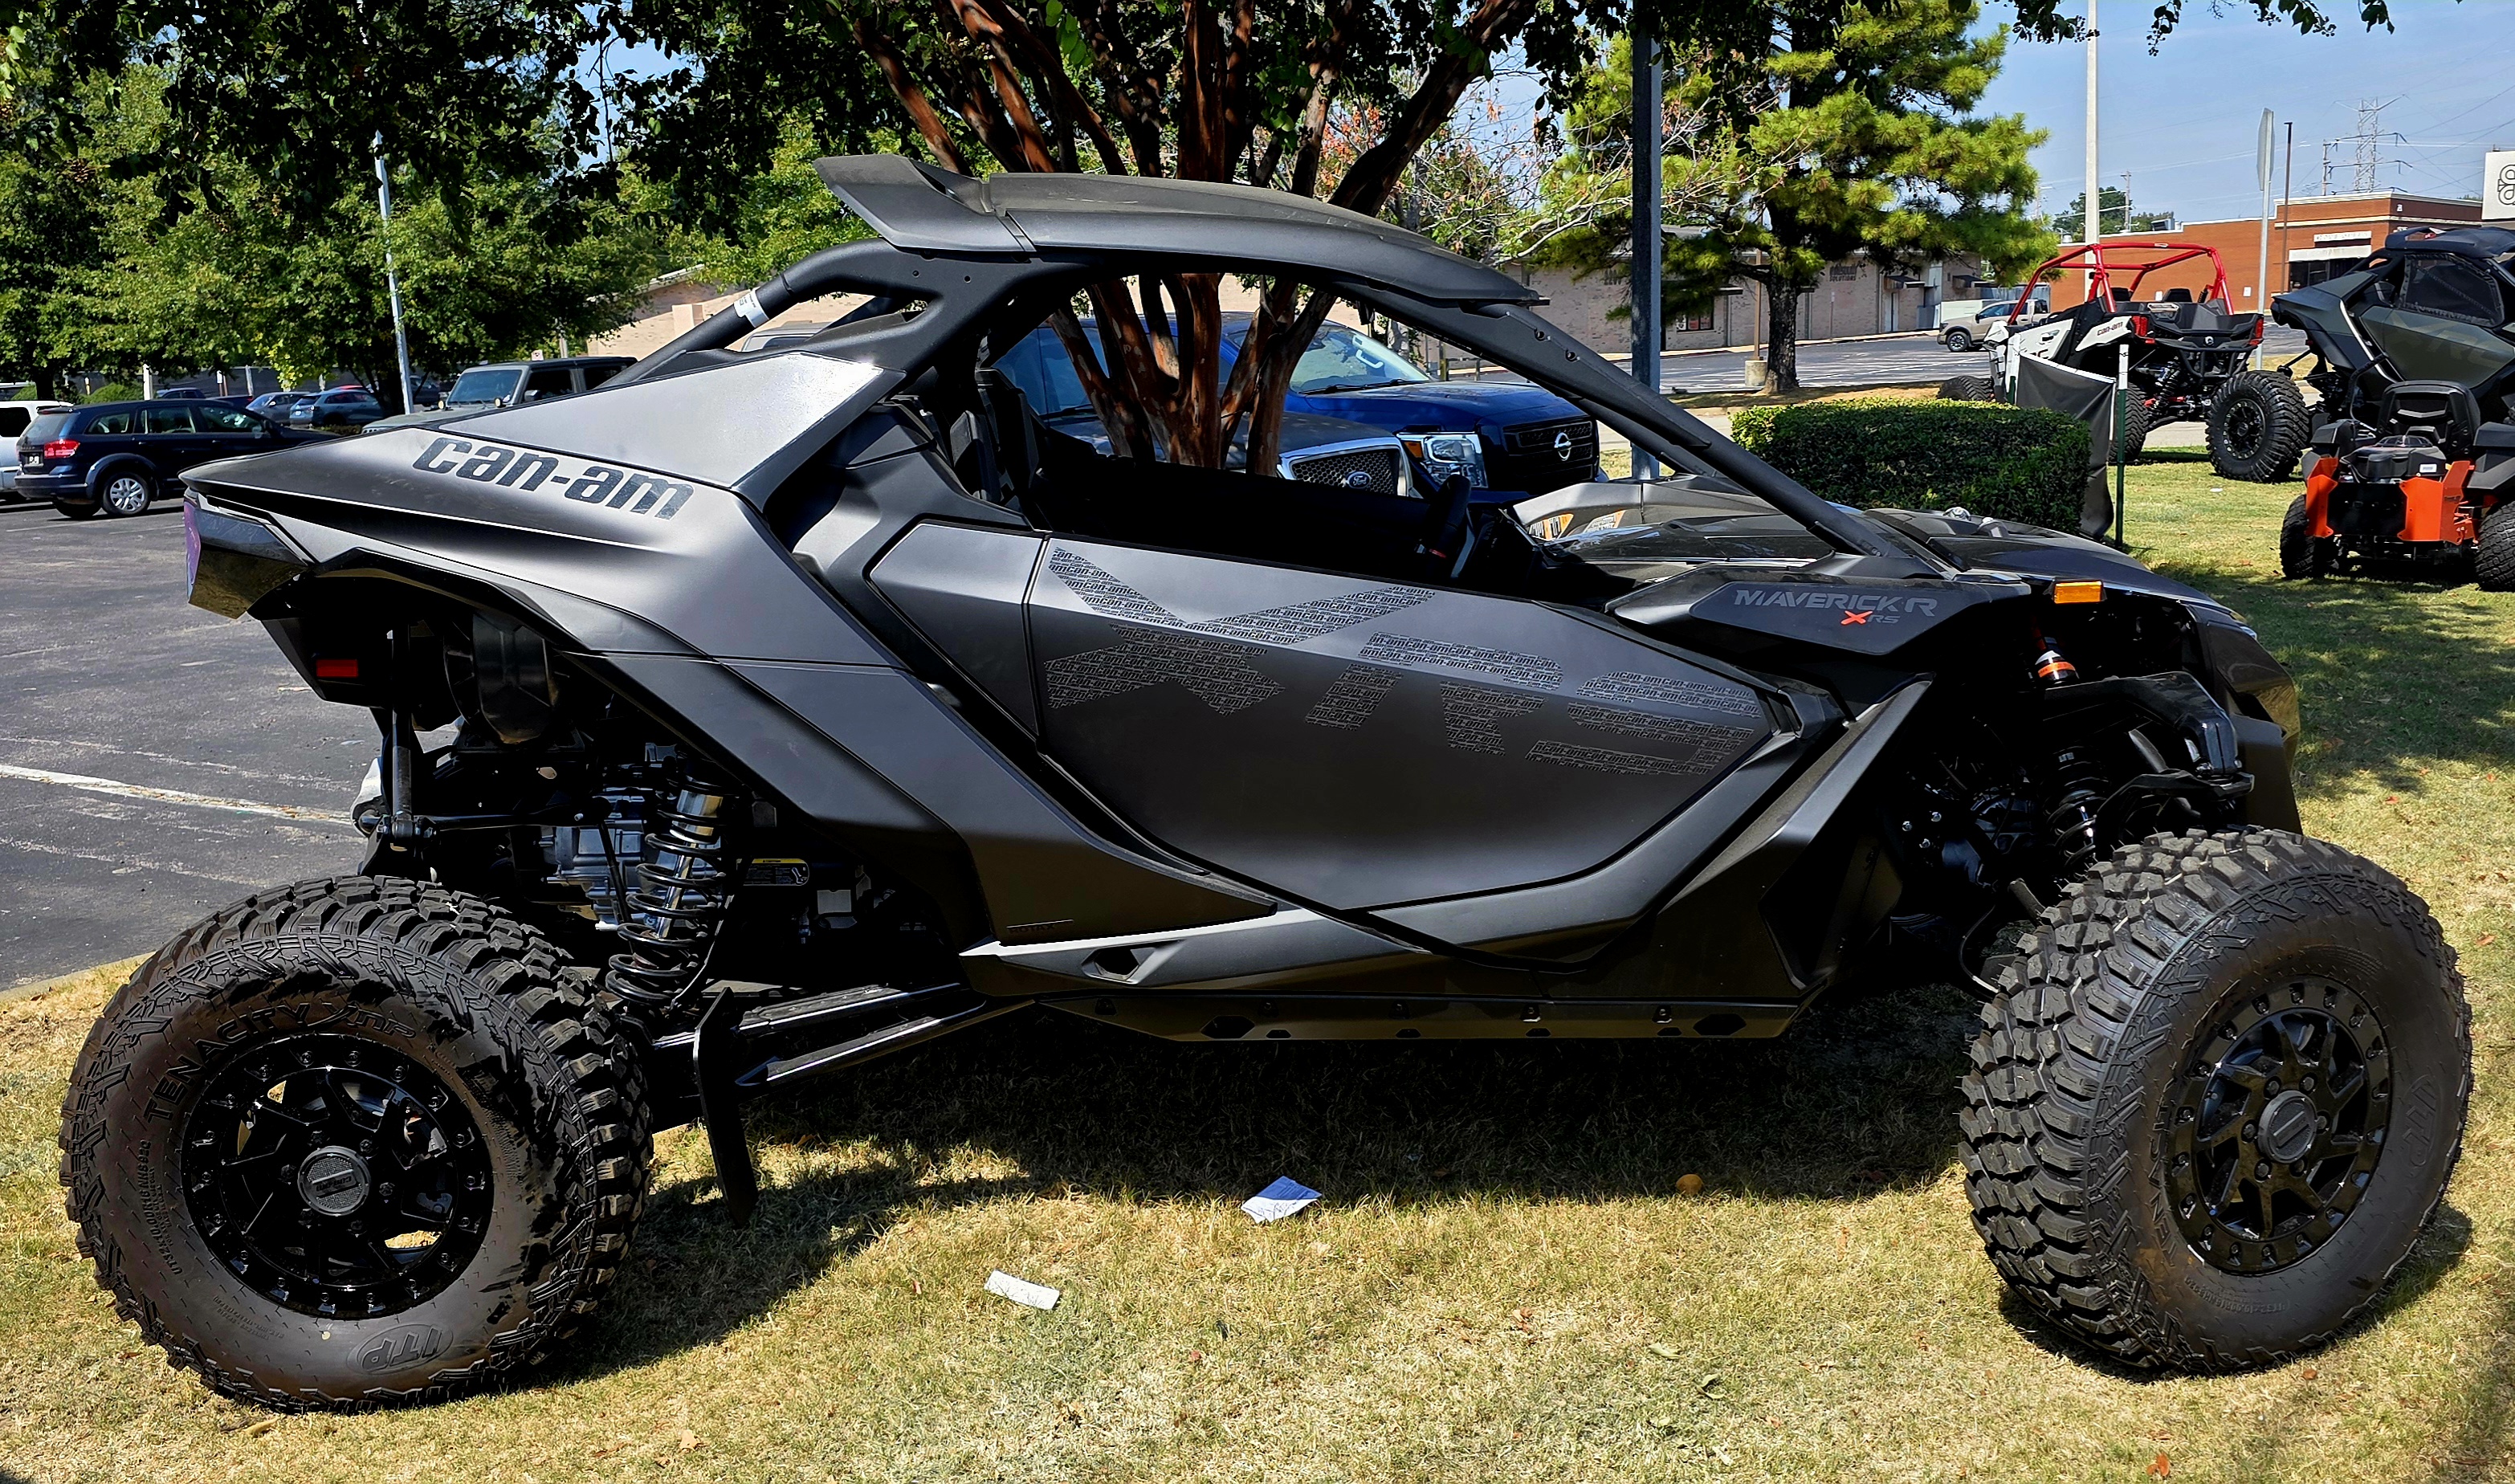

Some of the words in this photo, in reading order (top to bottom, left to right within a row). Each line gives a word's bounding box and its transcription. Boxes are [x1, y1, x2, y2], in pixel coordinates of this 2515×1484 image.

[2096, 321, 2124, 336] can-am
[412, 437, 695, 521] can-am
[1734, 589, 1899, 612] MAVERICK
[1905, 597, 1938, 617] R
[359, 1326, 444, 1373] ITP
